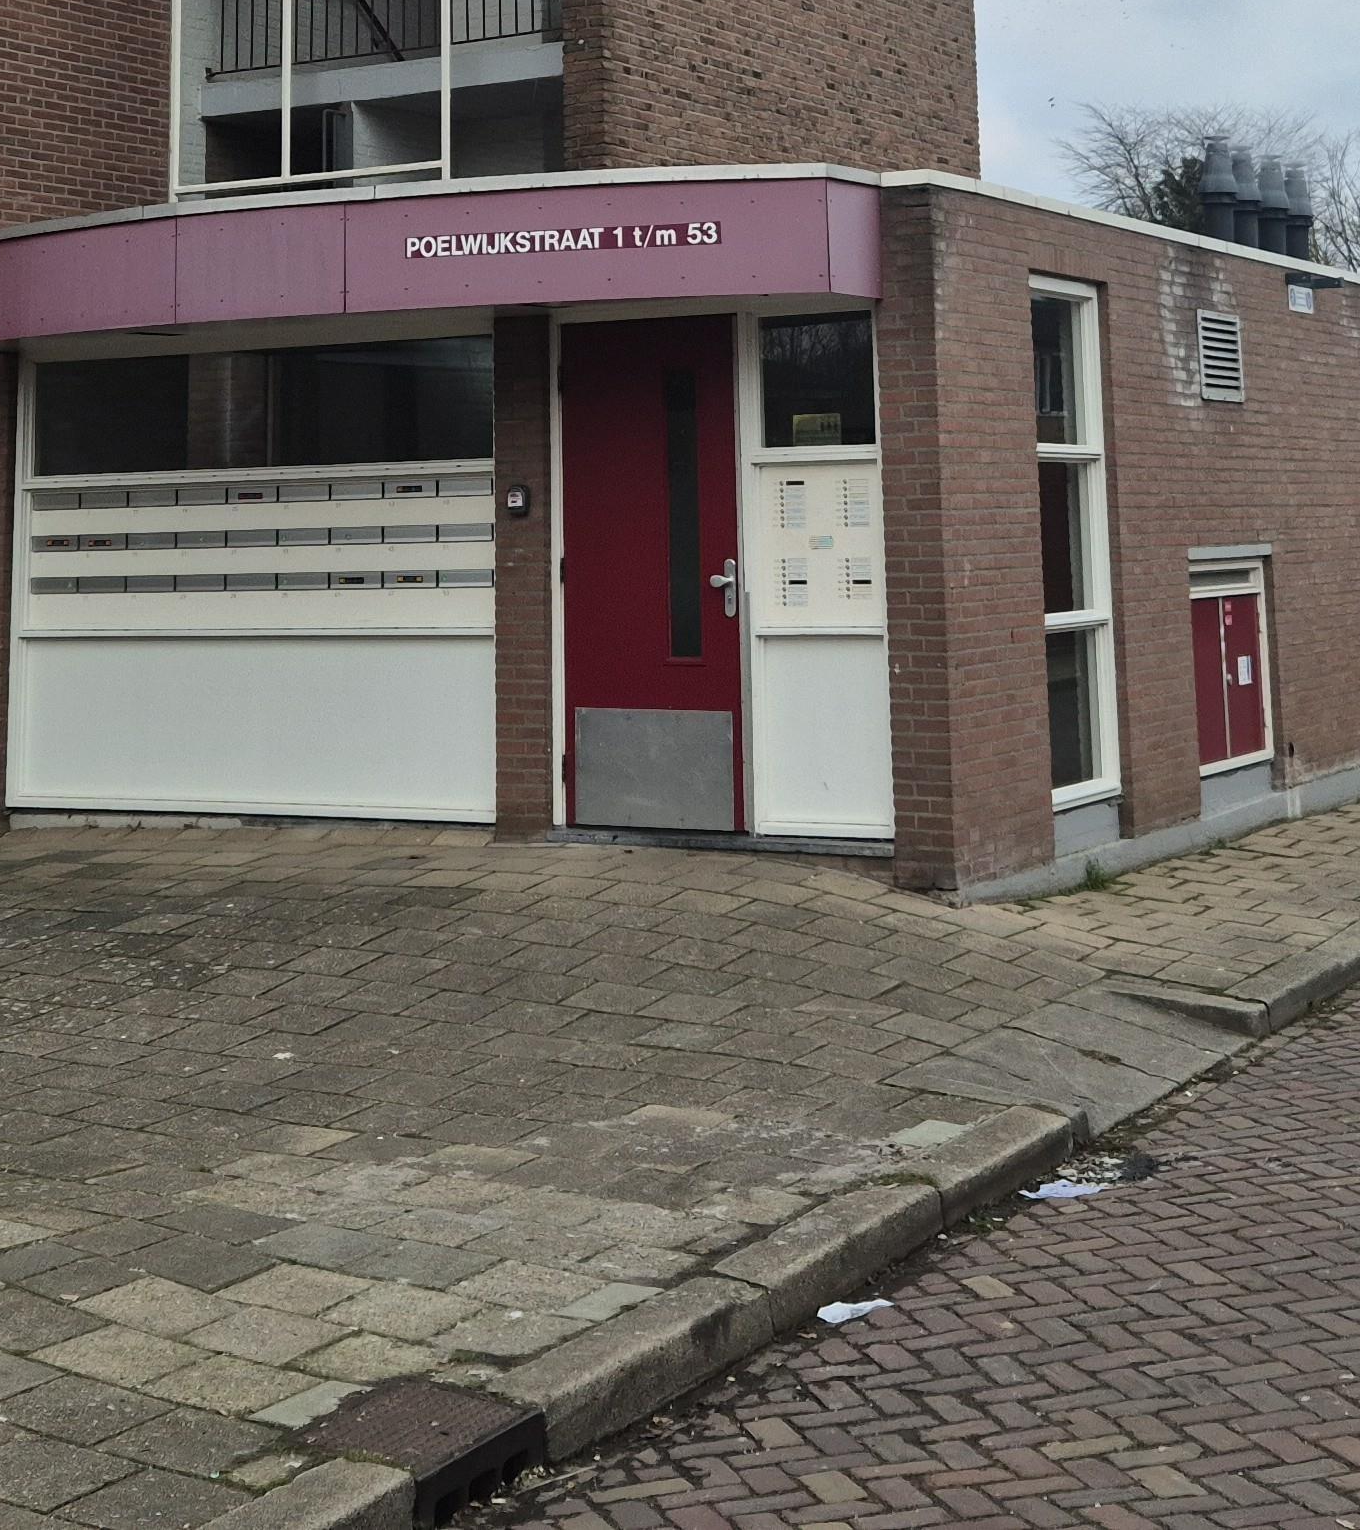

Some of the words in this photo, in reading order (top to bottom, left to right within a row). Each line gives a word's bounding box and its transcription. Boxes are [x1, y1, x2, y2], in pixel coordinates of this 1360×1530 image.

[406, 227, 605, 258] POELWIJKSTRAAT
[612, 226, 624, 248] 1
[633, 225, 677, 249] t/m
[686, 221, 718, 245] 53
